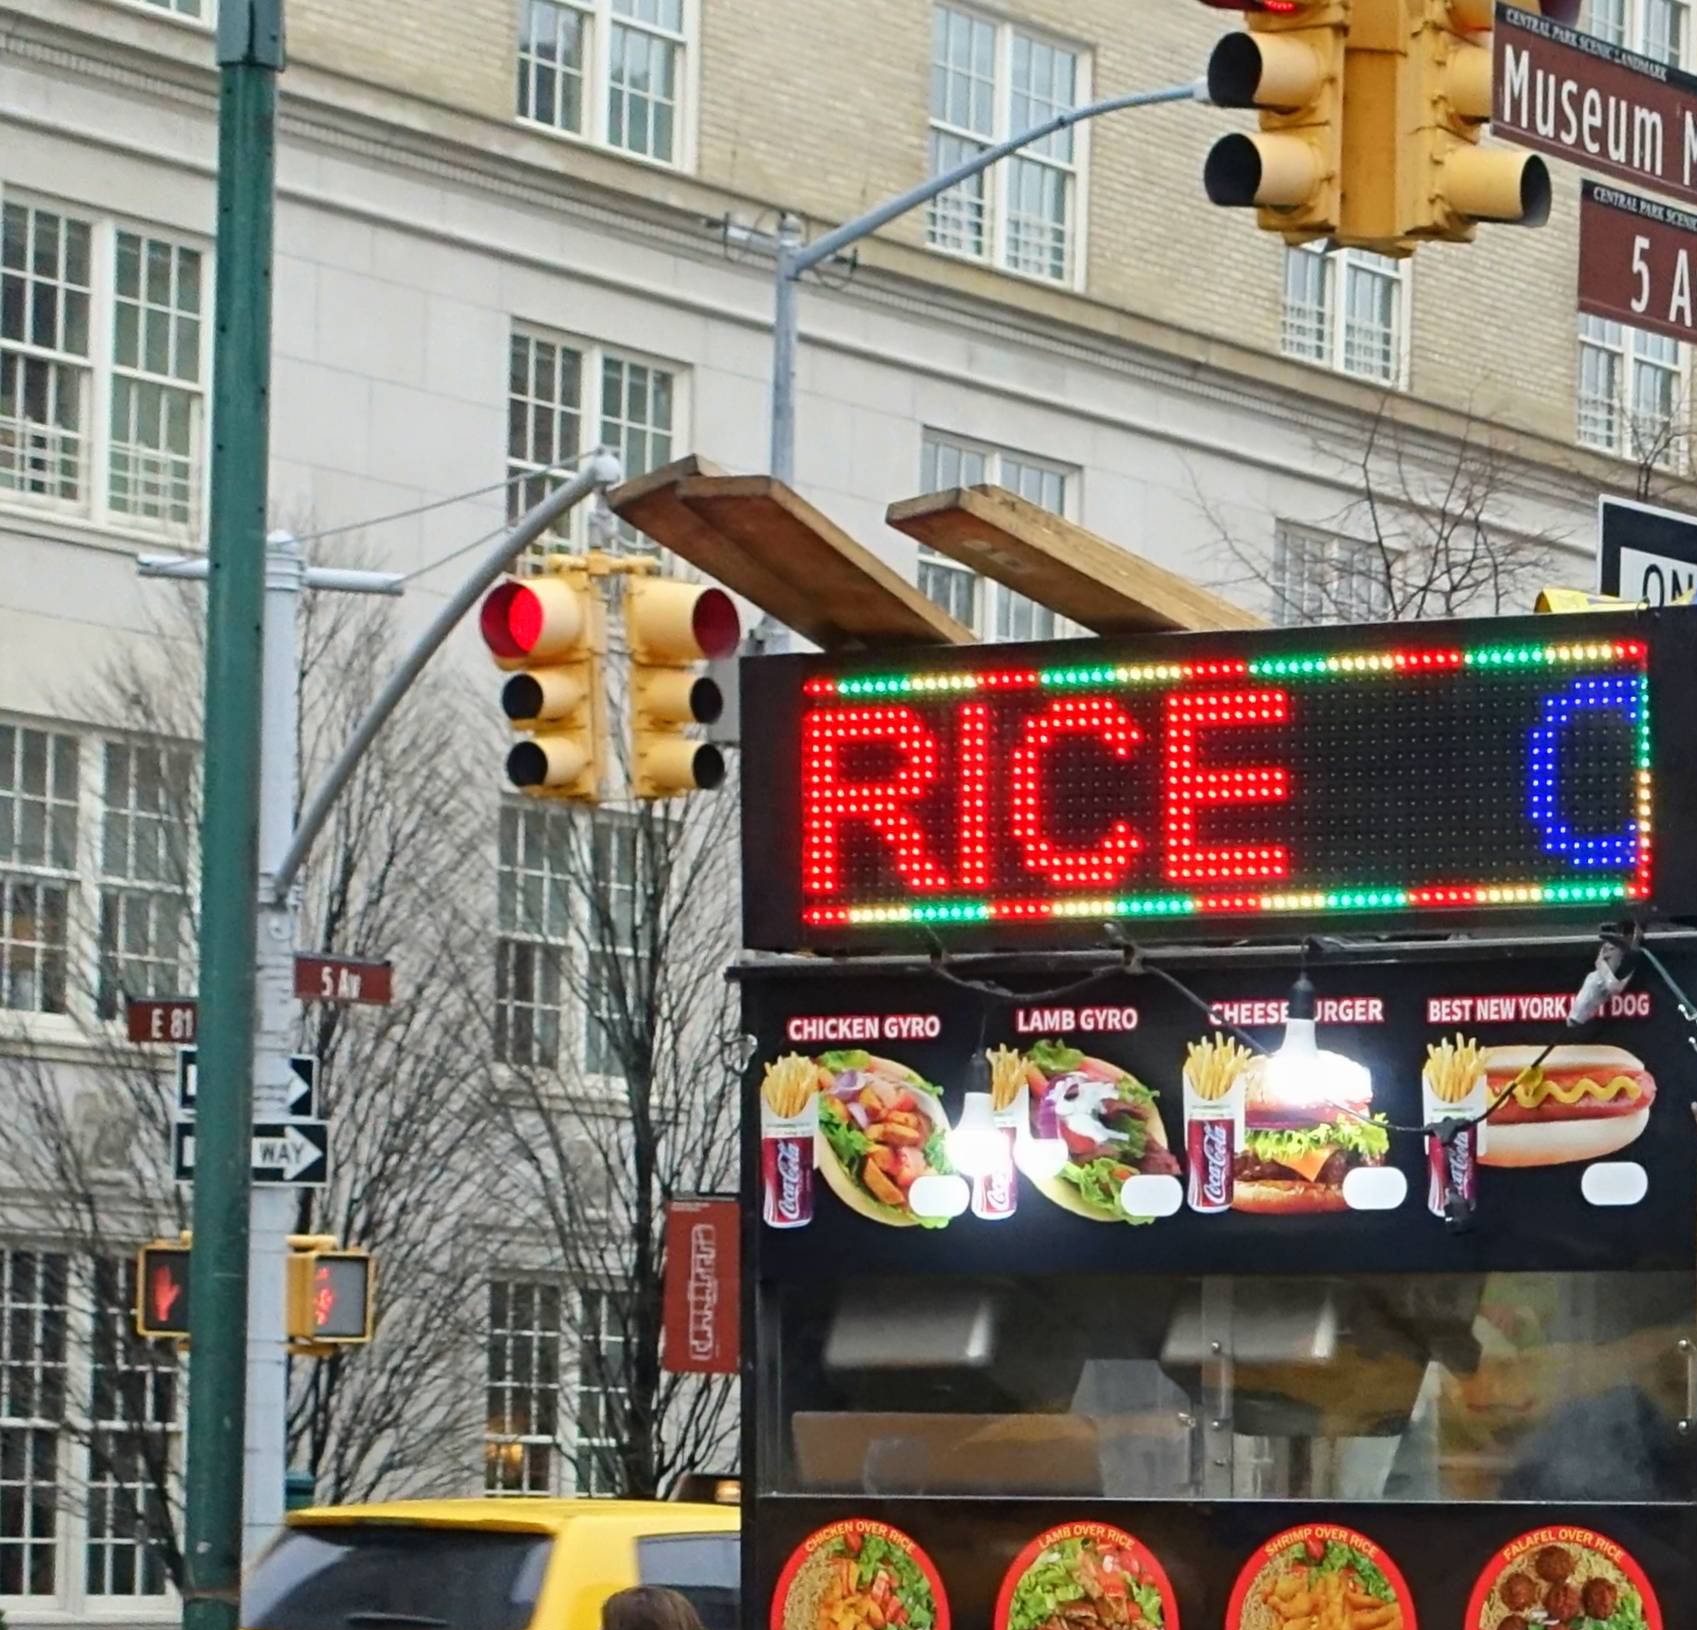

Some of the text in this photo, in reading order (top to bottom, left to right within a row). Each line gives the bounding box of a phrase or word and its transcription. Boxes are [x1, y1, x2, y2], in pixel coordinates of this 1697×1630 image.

[1553, 22, 1578, 47] PARK
[1503, 44, 1663, 177] Museum
[1593, 186, 1638, 212] CENTRAL
[1640, 199, 1665, 222] PARK
[1631, 234, 1650, 313] 5
[802, 688, 1292, 893] RICE
[321, 965, 362, 998] 5 Av
[151, 1007, 193, 1039] E 81
[1018, 1007, 1139, 1032] LAMB GYRO
[1208, 999, 1384, 1026] CHEESEURGER
[1428, 994, 1650, 1023] BEST NEW YORK DOG
[788, 1015, 941, 1040] CHICKEN GYRO
[259, 1143, 304, 1163] WAY
[803, 1519, 917, 1556] CHICKEN OVER RICE
[1037, 1523, 1135, 1553] LAMB OVER RICE
[1265, 1525, 1380, 1560] SHRIMP OVER RICE
[1503, 1528, 1625, 1563] FALAFEL OVER RICE
